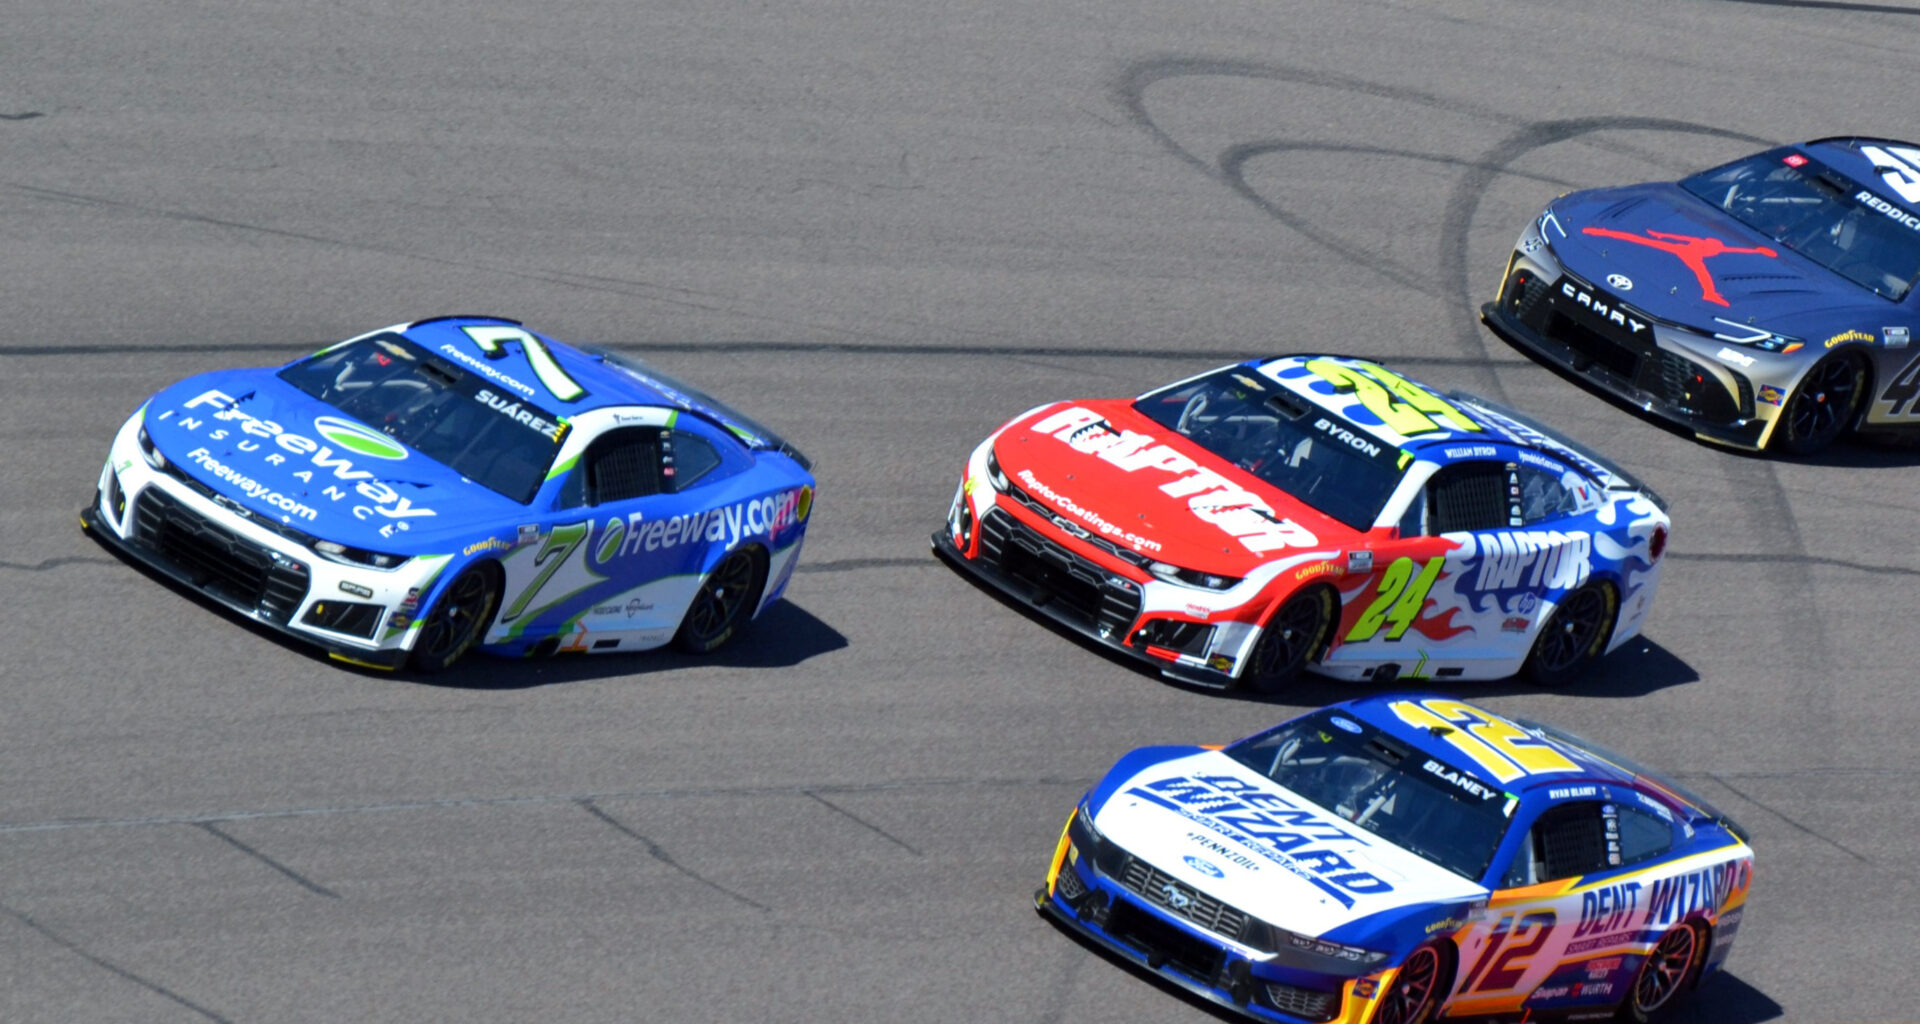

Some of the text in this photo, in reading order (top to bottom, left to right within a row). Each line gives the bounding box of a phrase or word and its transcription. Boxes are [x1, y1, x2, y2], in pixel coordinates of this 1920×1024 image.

[1562, 282, 1646, 332] CAMRY
[1824, 329, 1876, 348] GOODYEAR
[440, 344, 536, 396] Freeway.com
[459, 325, 584, 402] 7
[1305, 359, 1481, 436] 24
[1880, 352, 1920, 417] 4
[475, 389, 561, 438] SUÁREZ
[1314, 418, 1381, 458] BYRON
[158, 409, 397, 539] INSURANCE
[183, 389, 438, 519] Freeway
[186, 447, 319, 521] Freeway.com
[1030, 407, 1319, 553] RAPTOR
[1444, 446, 1497, 459] WILLIAM BYRON
[619, 489, 797, 557] Freeway.com
[1017, 469, 1162, 552] RaptorCoatings.com
[502, 521, 590, 624] 7
[1295, 559, 1345, 580] GOODYEAR
[1474, 530, 1592, 592] RAPTOR
[1343, 556, 1446, 643] 24
[1388, 699, 1585, 784] 12
[1192, 775, 1373, 848] DENT
[1423, 760, 1497, 801] BLANEY
[1549, 786, 1597, 799] RYAN BLANEY
[1144, 776, 1395, 895] WIZARD
[1191, 834, 1255, 871] PENNZOIL
[1573, 859, 1737, 938] DENT WIZARD
[1456, 908, 1557, 996] 12
